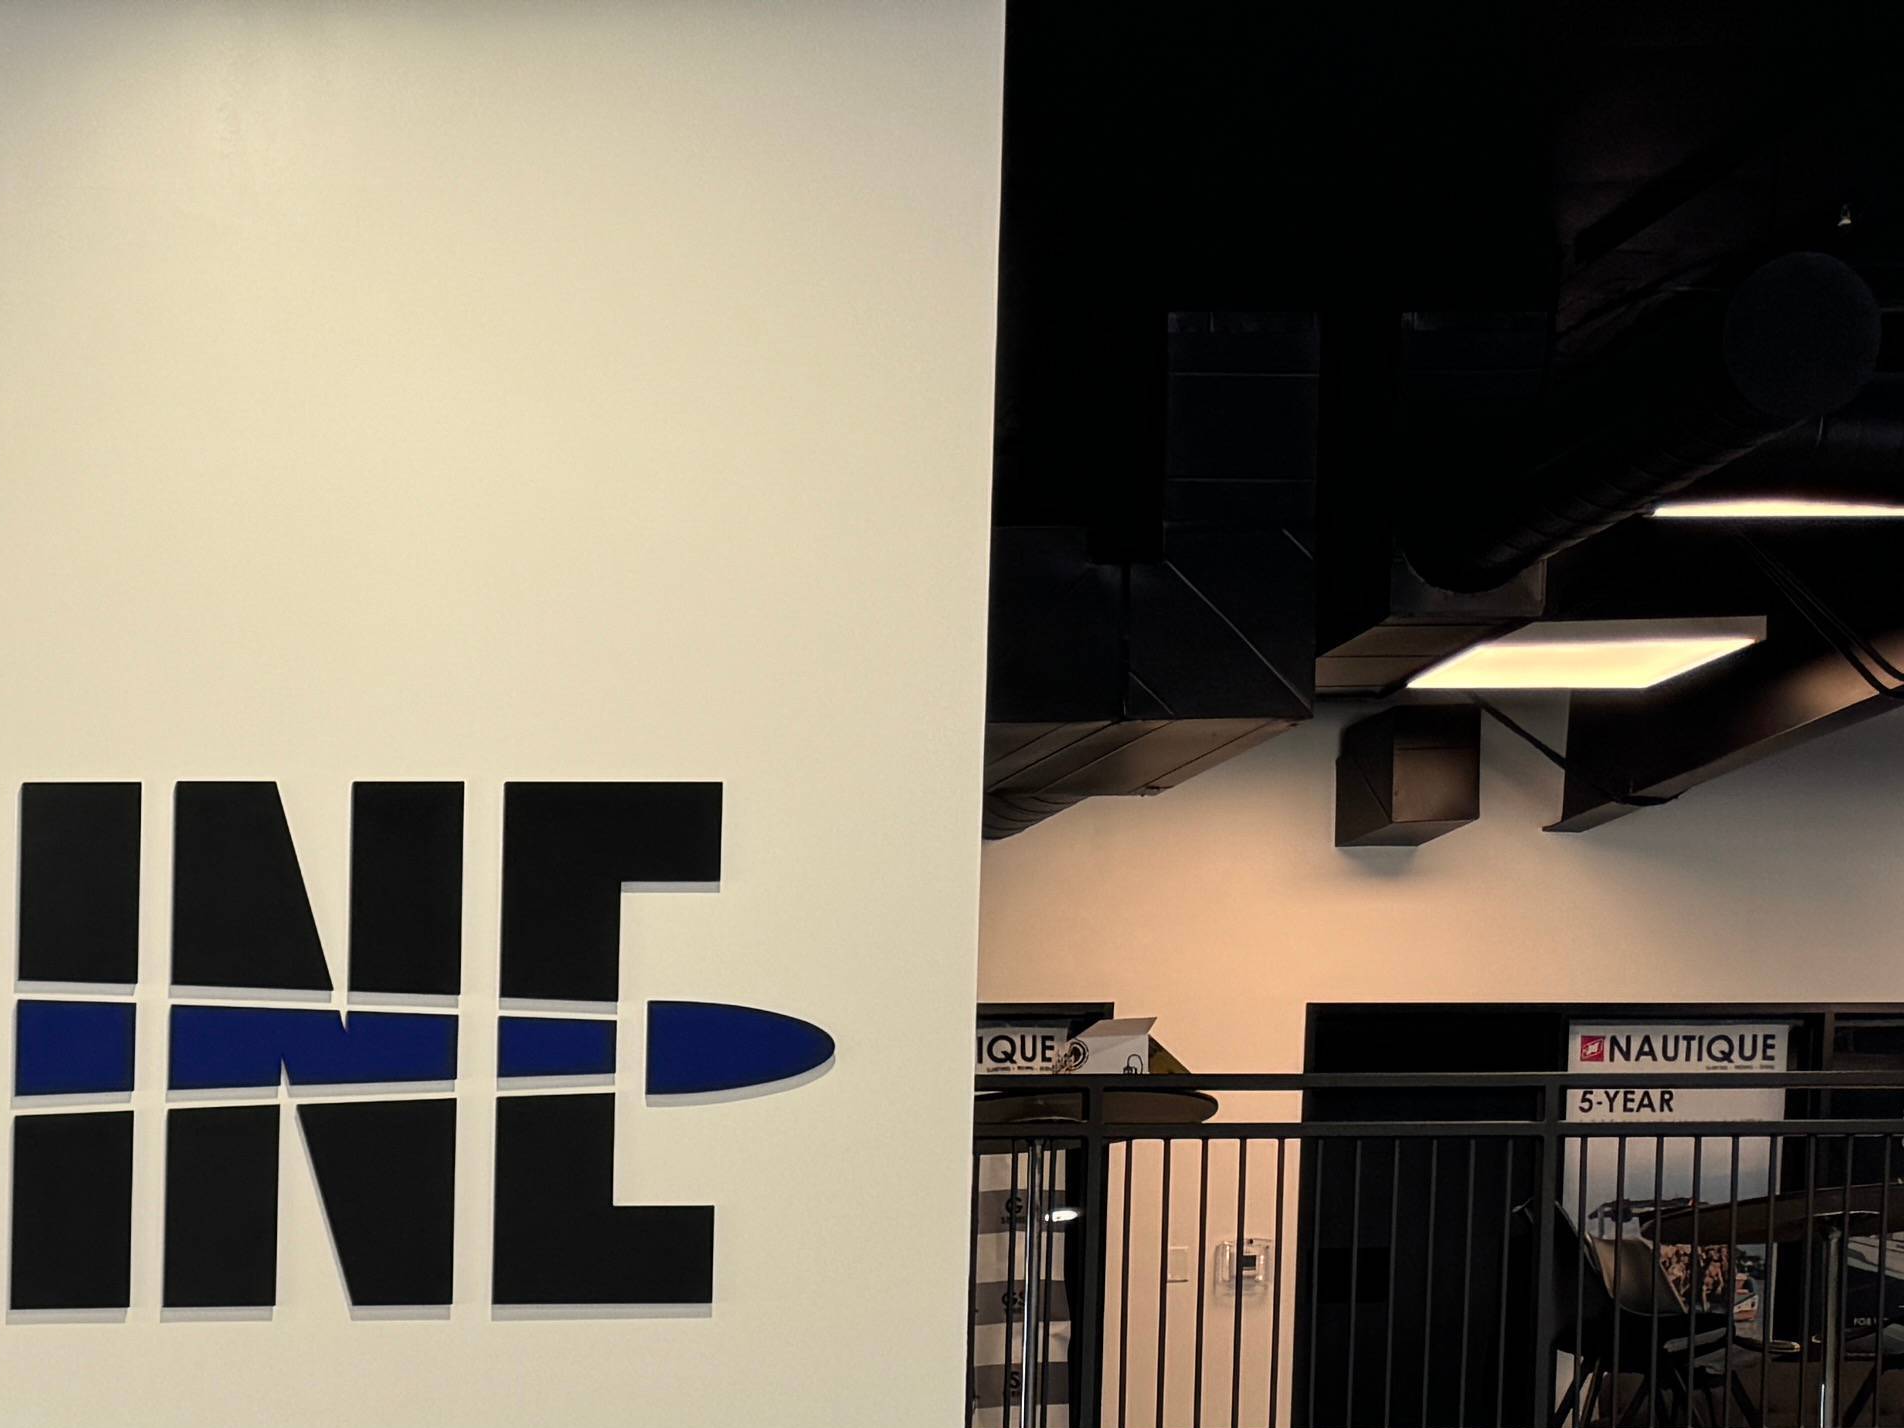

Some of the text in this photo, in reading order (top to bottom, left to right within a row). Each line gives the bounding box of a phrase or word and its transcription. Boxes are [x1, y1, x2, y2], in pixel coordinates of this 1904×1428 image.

[977, 1035, 1055, 1064] IQUE
[1609, 1034, 1776, 1063] NAUTIQUE
[1578, 1090, 1674, 1113] 5-YEAR
